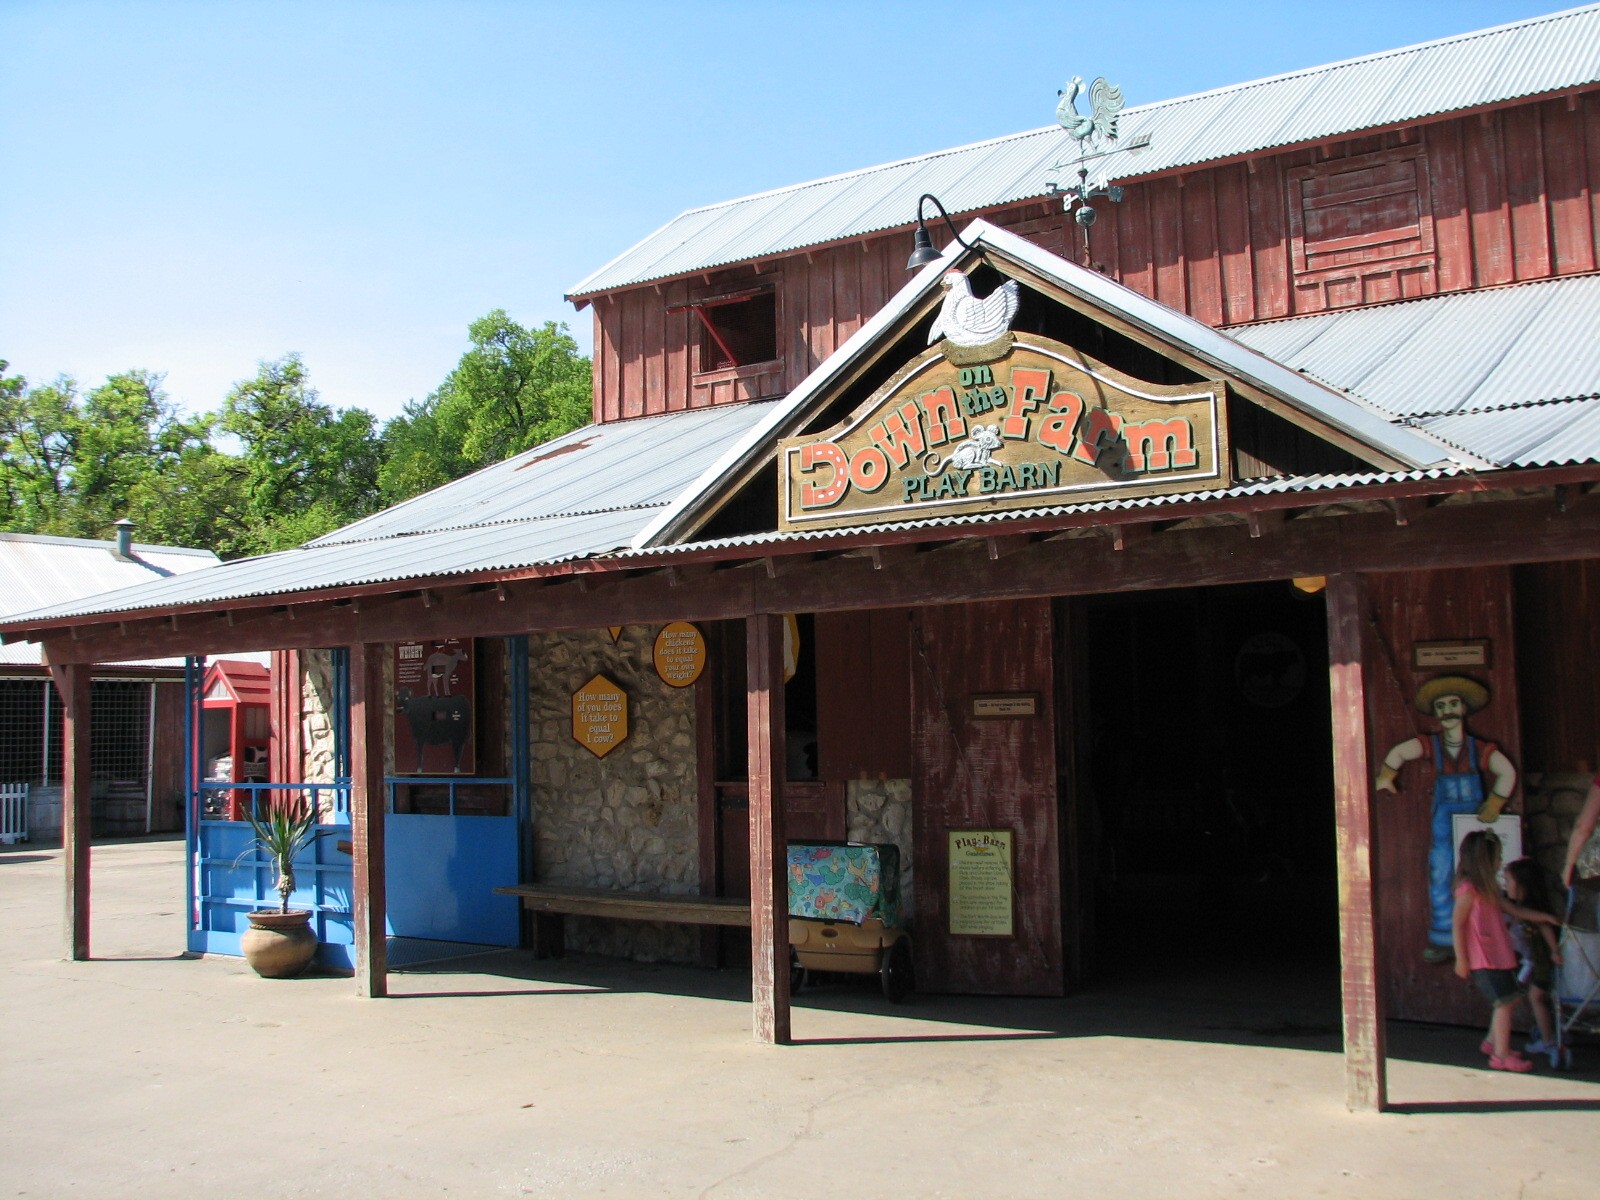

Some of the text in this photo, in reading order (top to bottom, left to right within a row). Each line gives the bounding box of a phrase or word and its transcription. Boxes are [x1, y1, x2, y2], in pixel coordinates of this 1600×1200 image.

[799, 364, 1200, 510] Down on the Farm
[901, 460, 1063, 502] PLAY BARN
[662, 630, 697, 641] How many
[659, 646, 698, 656] does it take
[675, 654, 693, 664] equal
[664, 664, 679, 673] your
[578, 691, 620, 704] How many
[577, 702, 622, 714] of you does
[581, 712, 618, 722] it take to
[589, 722, 611, 735] equal
[594, 733, 614, 743] cow?
